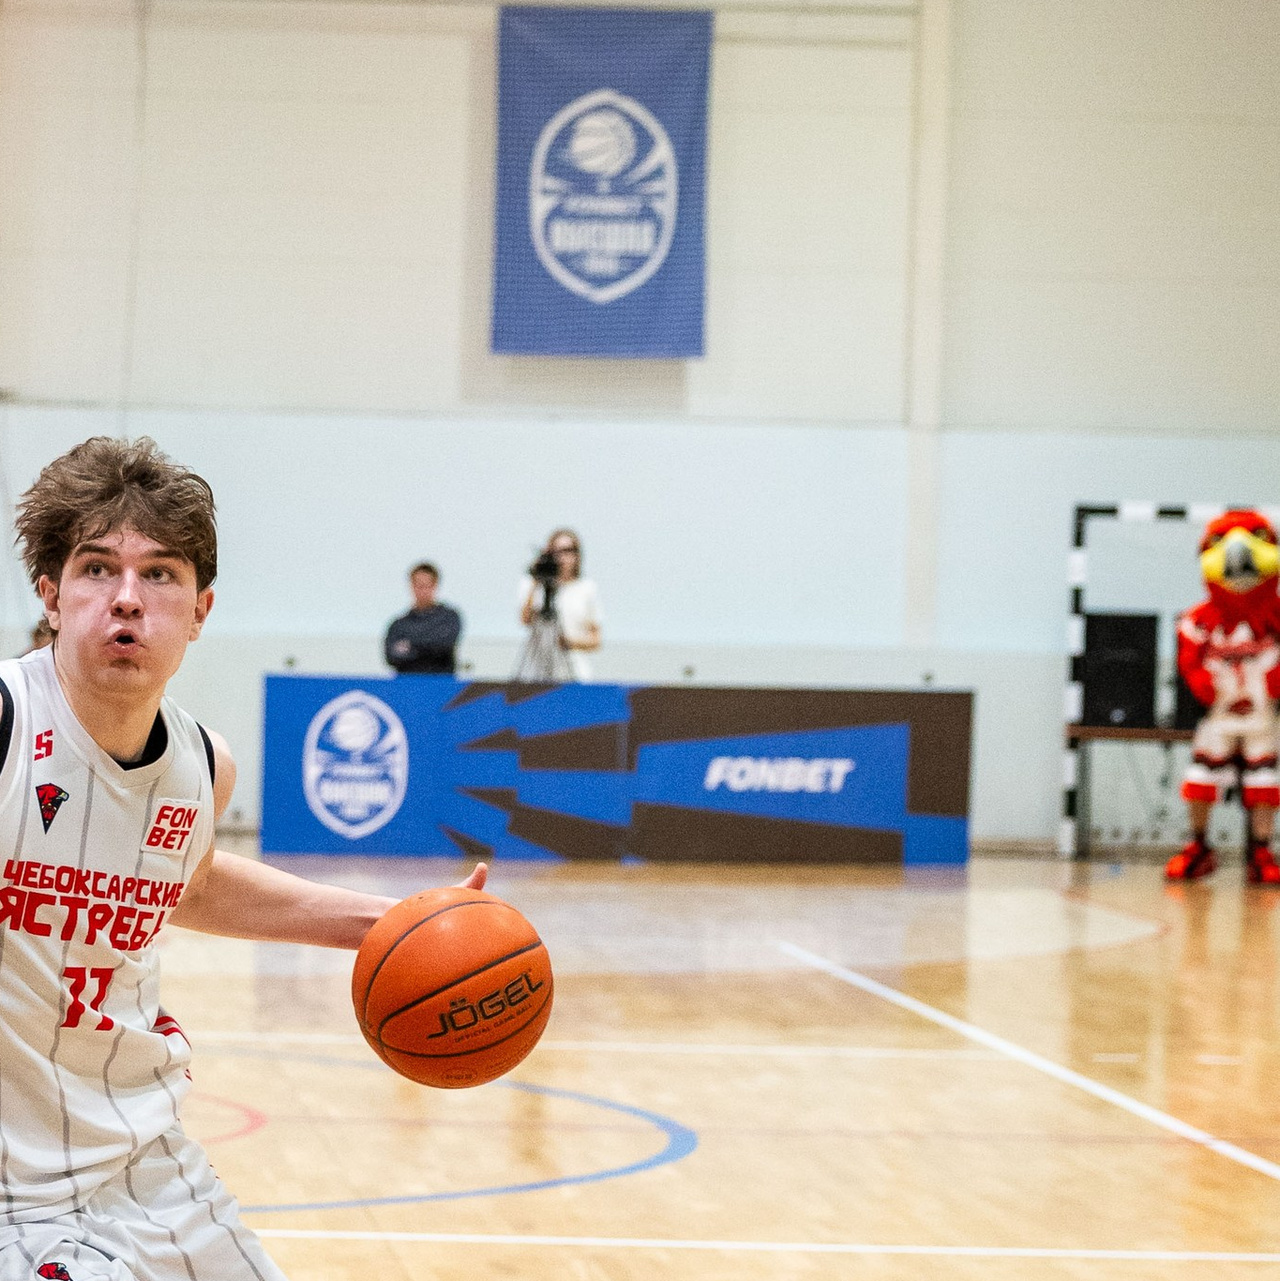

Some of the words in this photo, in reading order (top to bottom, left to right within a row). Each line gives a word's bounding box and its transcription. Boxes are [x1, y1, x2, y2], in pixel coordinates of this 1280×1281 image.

[703, 755, 856, 794] FONBET
[156, 805, 199, 829] FON
[146, 828, 190, 851] BET
[2, 858, 185, 909] ЧЕБОКСАРСКИЕ
[426, 972, 544, 1040] JÖGEL
